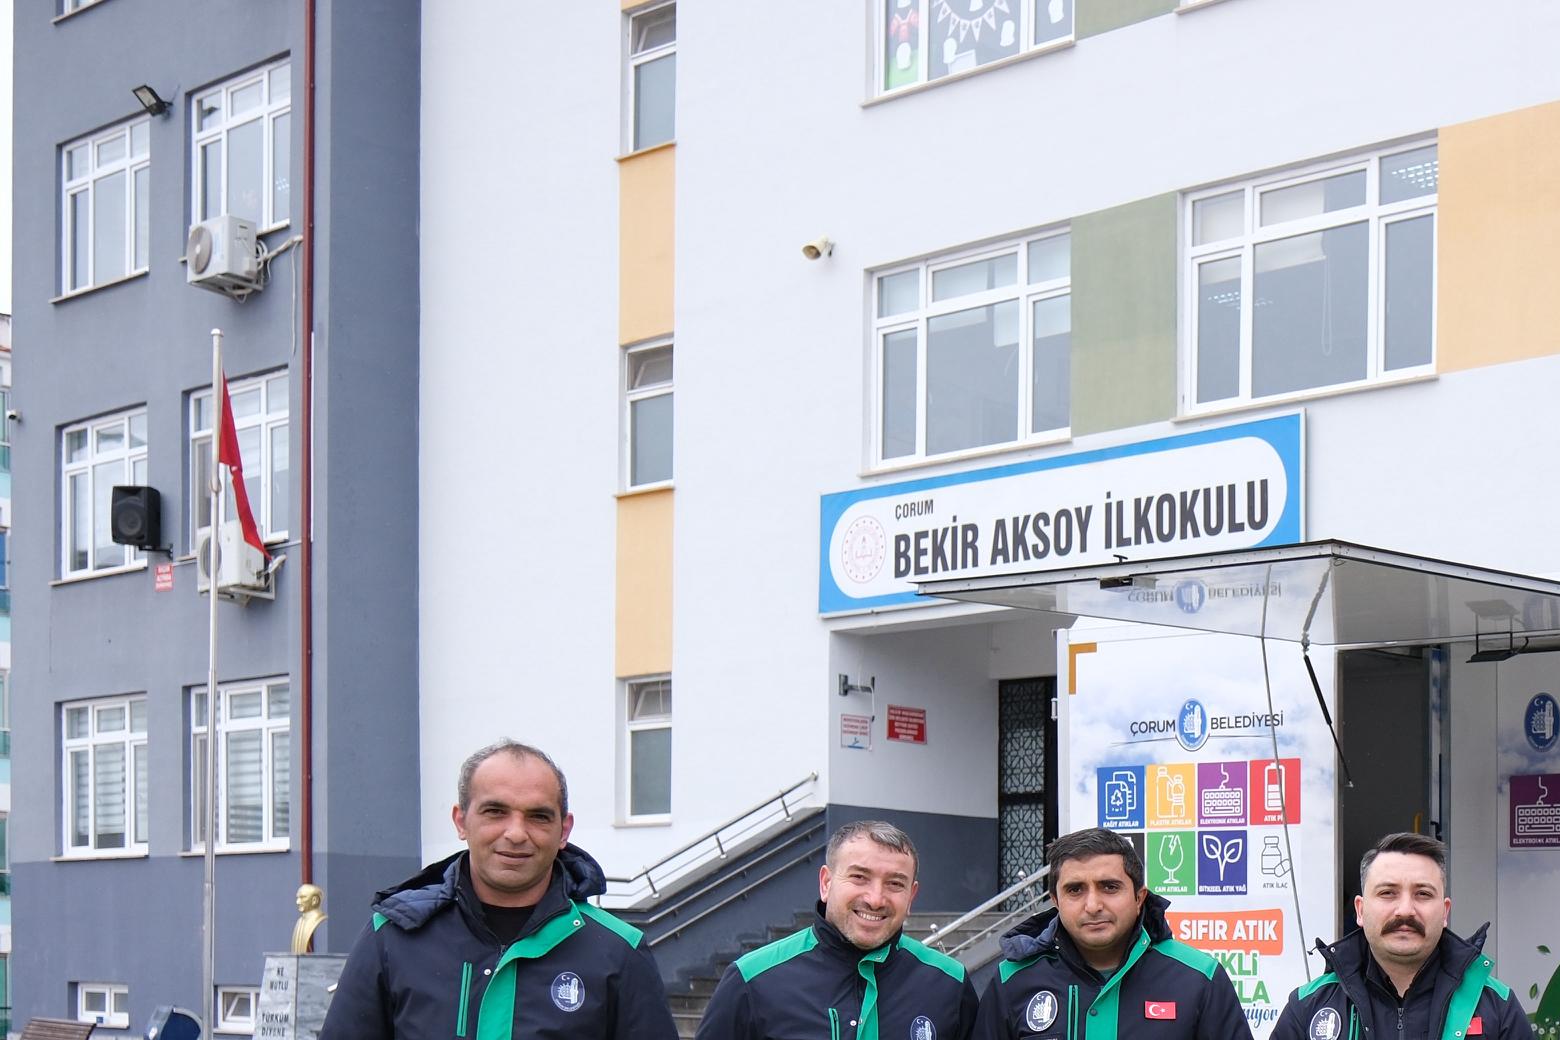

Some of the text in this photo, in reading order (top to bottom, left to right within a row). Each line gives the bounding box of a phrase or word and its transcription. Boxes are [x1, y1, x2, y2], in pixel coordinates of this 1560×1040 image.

[895, 499, 934, 520] ÇORUM
[894, 479, 1268, 579] BEKİR AKSOY İLKOKULU
[1130, 710, 1284, 736] ÇORUM BELEDİYESİ
[1180, 919, 1278, 940] SIFIR ATIK
